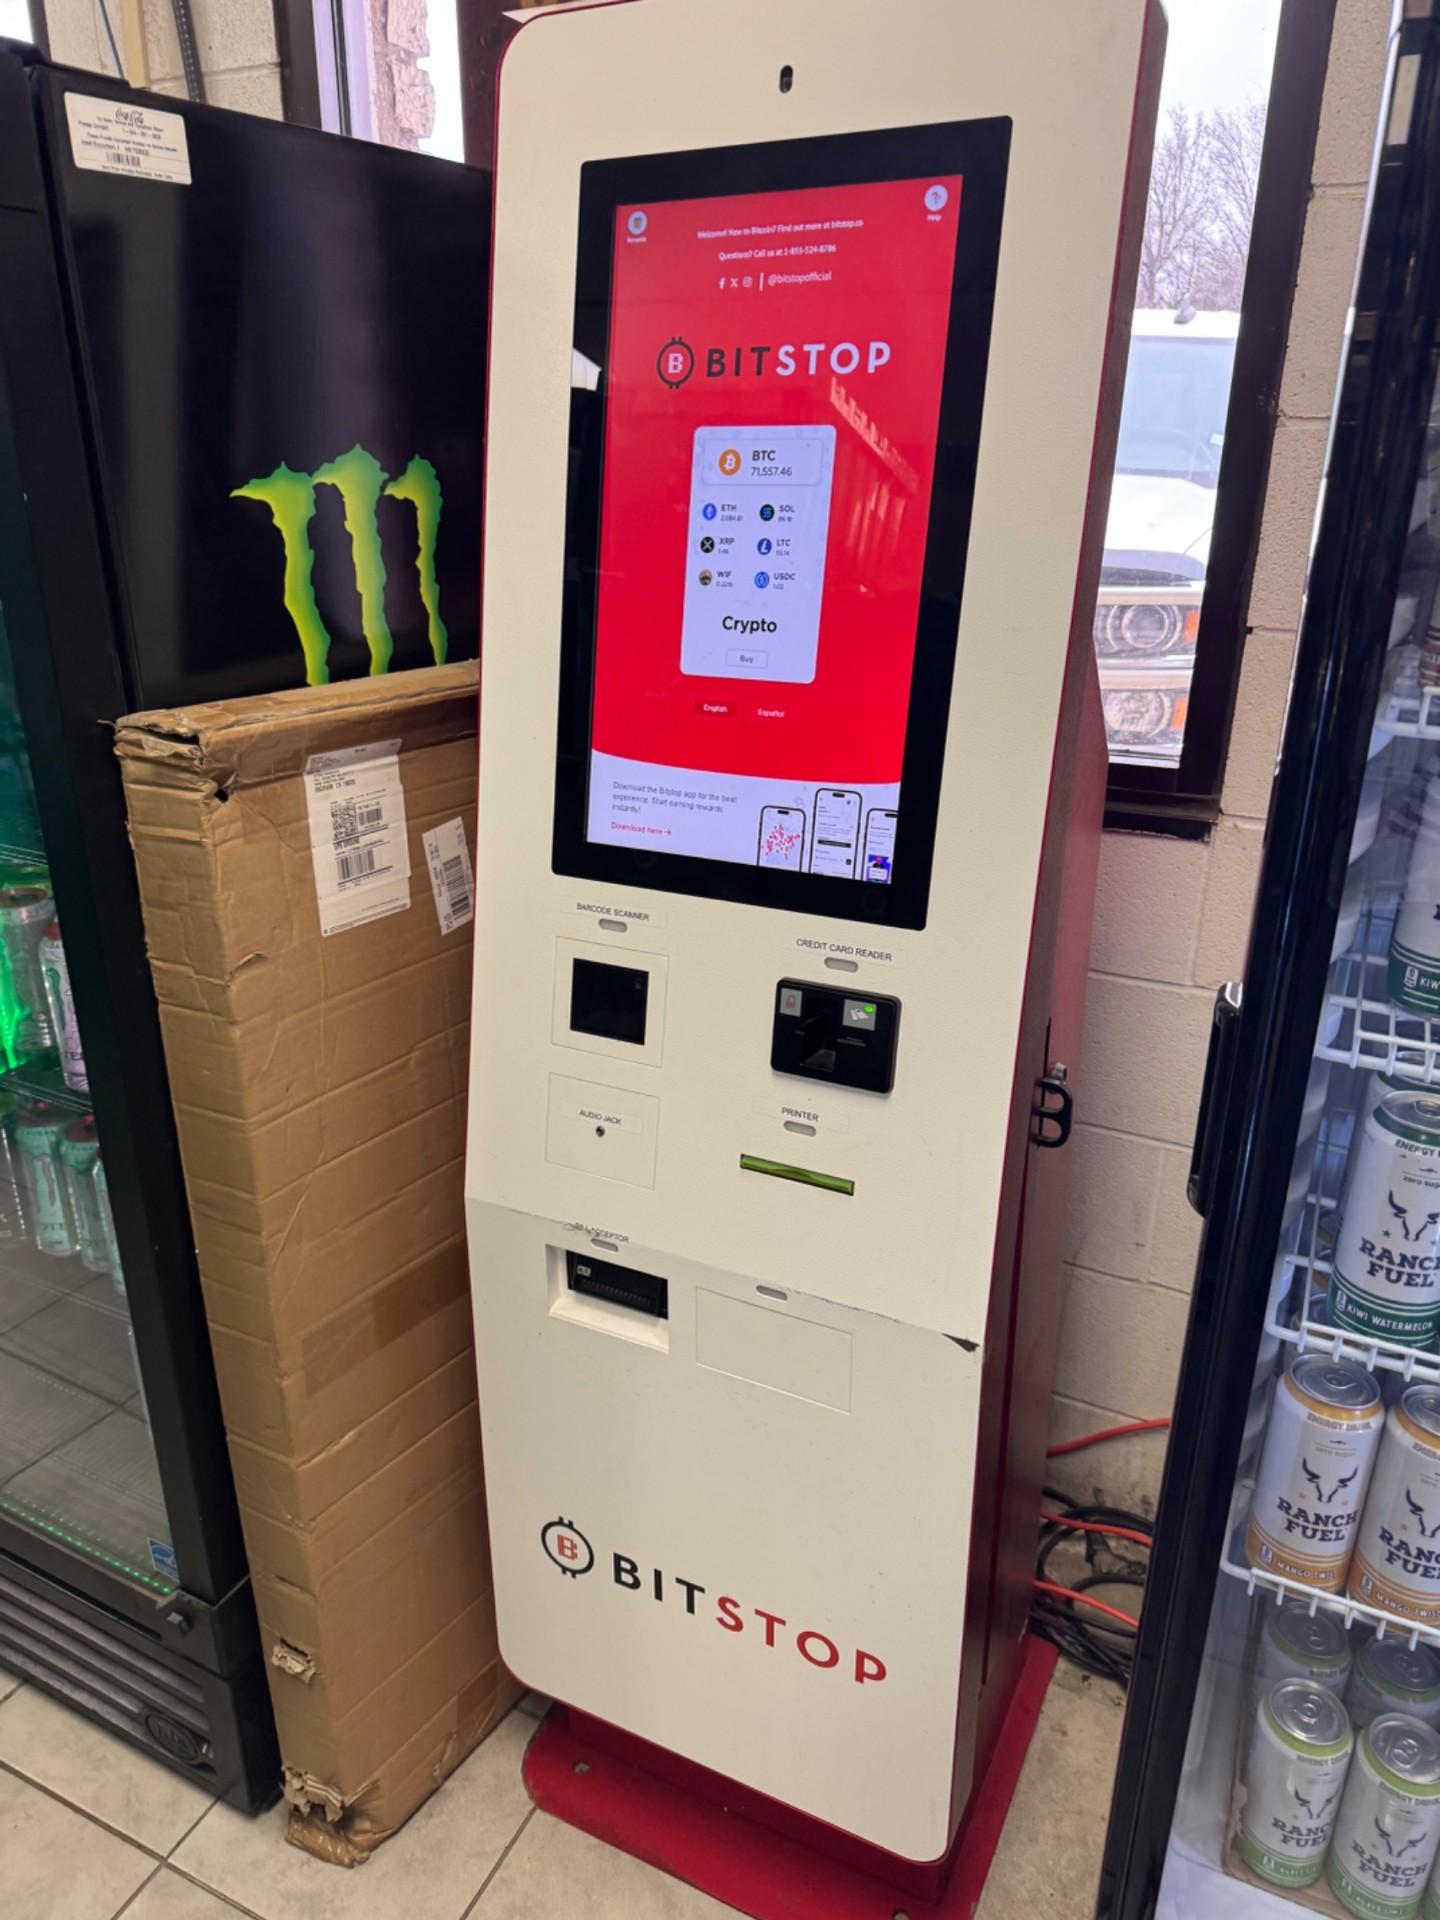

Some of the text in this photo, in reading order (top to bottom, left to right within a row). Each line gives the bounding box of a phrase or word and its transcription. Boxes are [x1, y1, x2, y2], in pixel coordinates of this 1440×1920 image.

[751, 225, 777, 236] Bitcoin?
[777, 223, 793, 233] Find
[719, 250, 753, 261] Questions?
[753, 248, 766, 258] Call
[767, 271, 833, 287] @bitstopofficial
[706, 341, 891, 378] BITSTOP
[752, 450, 777, 462] BTC
[720, 503, 737, 513] ETH
[778, 504, 795, 514] SOL
[718, 537, 735, 546] XRP
[775, 538, 791, 548] LTC
[773, 572, 796, 582] USDC
[722, 615, 778, 635] Crypto
[739, 654, 755, 665] Buy
[703, 703, 729, 713] English
[757, 708, 786, 718] Español
[612, 780, 646, 793] Download
[646, 785, 658, 794] the
[683, 791, 697, 800] app
[720, 794, 738, 803] best
[610, 821, 663, 836] Download here
[576, 902, 650, 921] BARCODE SCANNER
[796, 938, 893, 961] CREDIT CARD READER
[1420, 976, 1440, 991] KIW
[579, 1108, 623, 1126] AUDIO JACK
[781, 1106, 820, 1123] PRINTER
[1367, 1260, 1434, 1288] FUEL
[1347, 1303, 1433, 1332] KIWI WATERMELON
[1277, 1496, 1358, 1528] RANCH
[1284, 1518, 1345, 1542] FUEL
[1276, 1560, 1313, 1578] MANGO
[1385, 1548, 1440, 1580] FUE
[1375, 1593, 1411, 1615] MANGO
[612, 1552, 887, 1685] BITSTOP
[1271, 1816, 1331, 1838] RANC
[1351, 1839, 1429, 1877] RANCH
[1358, 1859, 1416, 1888] FUEL
